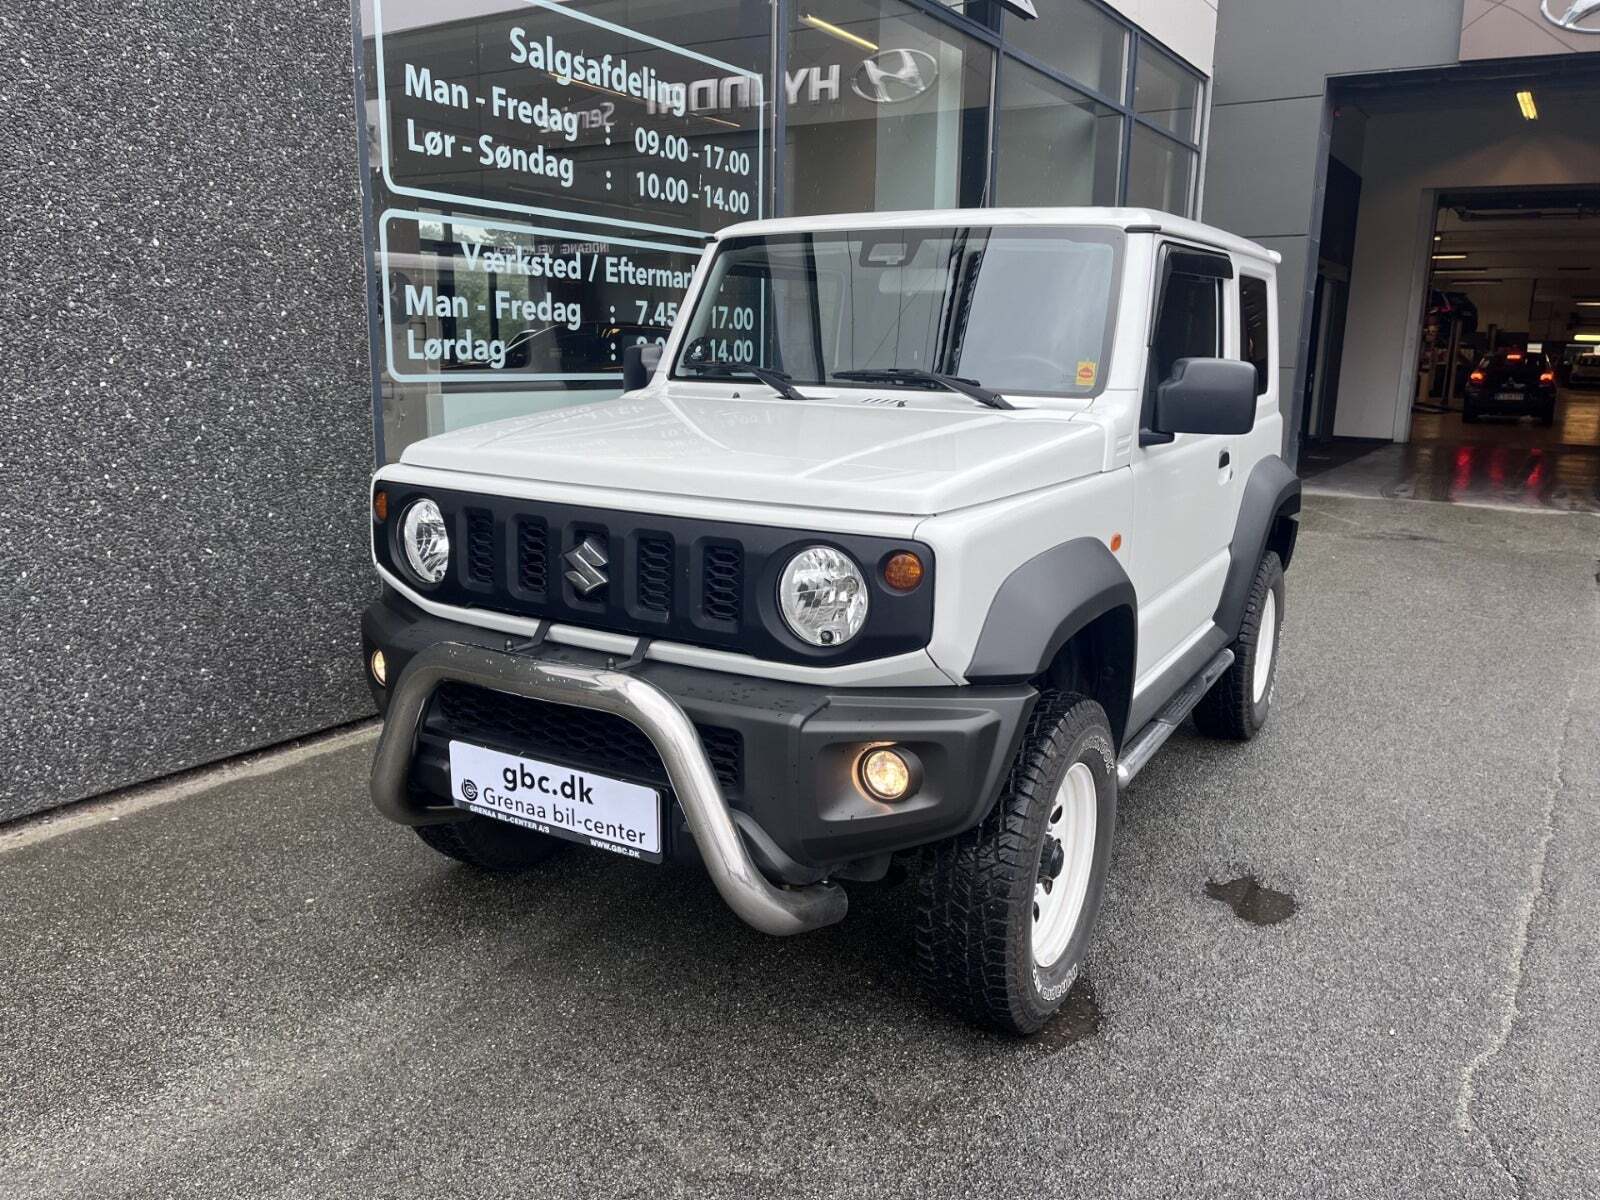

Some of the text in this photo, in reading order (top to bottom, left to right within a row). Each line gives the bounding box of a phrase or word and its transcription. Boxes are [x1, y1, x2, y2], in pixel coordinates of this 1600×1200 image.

[509, 27, 686, 117] Salgsafdeling
[404, 63, 469, 110] Man
[491, 86, 578, 141] Fredag
[634, 127, 689, 162] 09.00
[703, 144, 750, 176] 17.00
[407, 119, 456, 158] Lør
[479, 134, 574, 188] Søndag
[636, 171, 689, 203] 10.00
[703, 185, 750, 214] 14.00
[461, 241, 581, 281] Værksted
[605, 256, 697, 289] Eftermar
[404, 284, 469, 318] Man
[495, 291, 582, 331] Fredag
[635, 300, 679, 328] 7.45
[711, 305, 754, 331] 17.00
[407, 329, 506, 369] Lørdag
[709, 339, 754, 363] 14.00
[502, 763, 594, 805] gbc.dk
[469, 805, 497, 819] GRENAA
[483, 787, 646, 845] Grenaa bil-center
